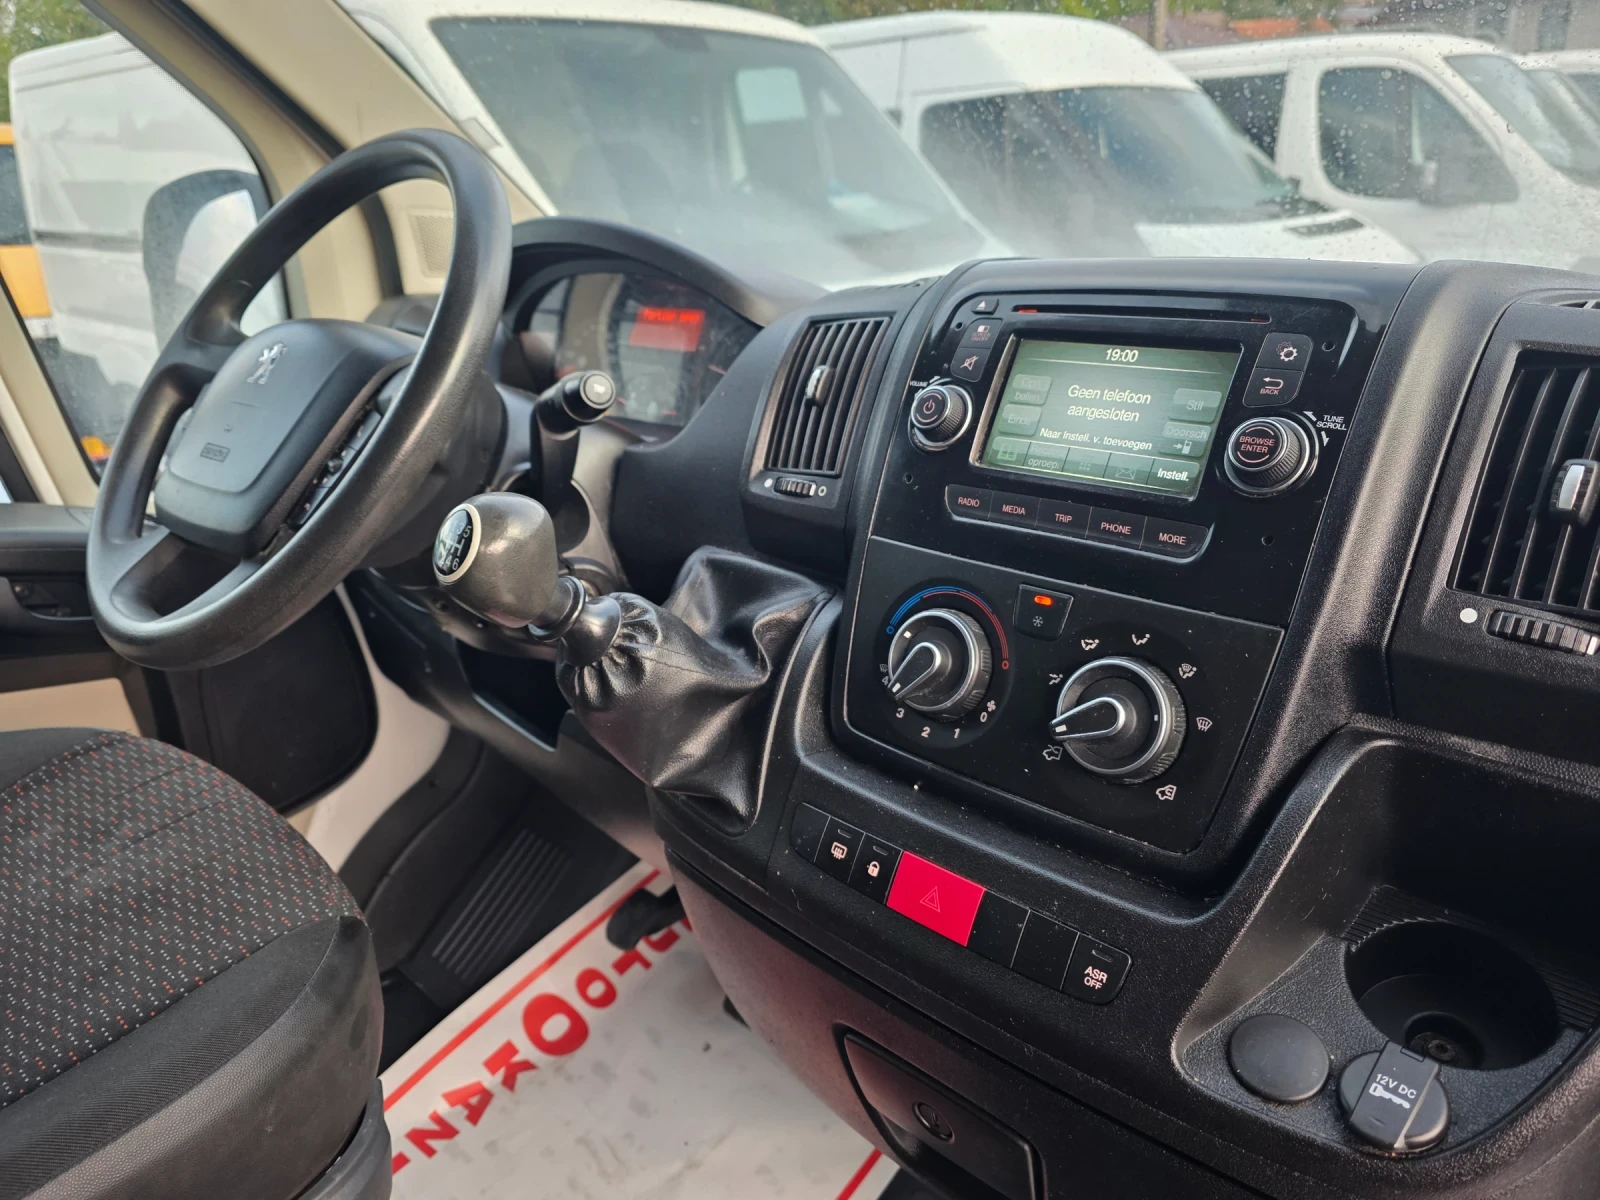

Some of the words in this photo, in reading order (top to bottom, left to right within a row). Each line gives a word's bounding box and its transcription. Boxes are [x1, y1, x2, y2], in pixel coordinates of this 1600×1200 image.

[1105, 348, 1139, 363] 19:00
[1067, 385, 1101, 400] Geen
[1102, 386, 1151, 405] telefoon
[1259, 388, 1280, 396] BACK
[1186, 399, 1205, 411] Stil
[1067, 404, 1140, 423] aangesloten
[1323, 414, 1345, 424] TUNE
[1316, 421, 1347, 431] SCROLL
[1039, 427, 1061, 441] Naar
[1062, 430, 1091, 444] Instell.
[1092, 435, 1102, 444] v.
[1103, 435, 1153, 451] toevoegen
[1239, 435, 1276, 446] BROWSE
[1240, 444, 1269, 454] ENTER
[1157, 467, 1190, 481] Instell.
[957, 496, 980, 508] RADIO
[1001, 504, 1026, 515] MEDIA
[1054, 513, 1073, 524] TRIP
[463, 525, 472, 538] 5
[1100, 521, 1132, 535] PHONE
[1158, 532, 1187, 546] MORE
[452, 558, 460, 571] 6
[895, 707, 905, 719] 3
[979, 711, 988, 723] 0
[921, 726, 931, 738] 2
[953, 727, 961, 739] 1
[1084, 965, 1108, 984] ASR
[1083, 976, 1103, 990] OFF
[1375, 1073, 1398, 1089] 12V
[1398, 1084, 1417, 1099] DC
